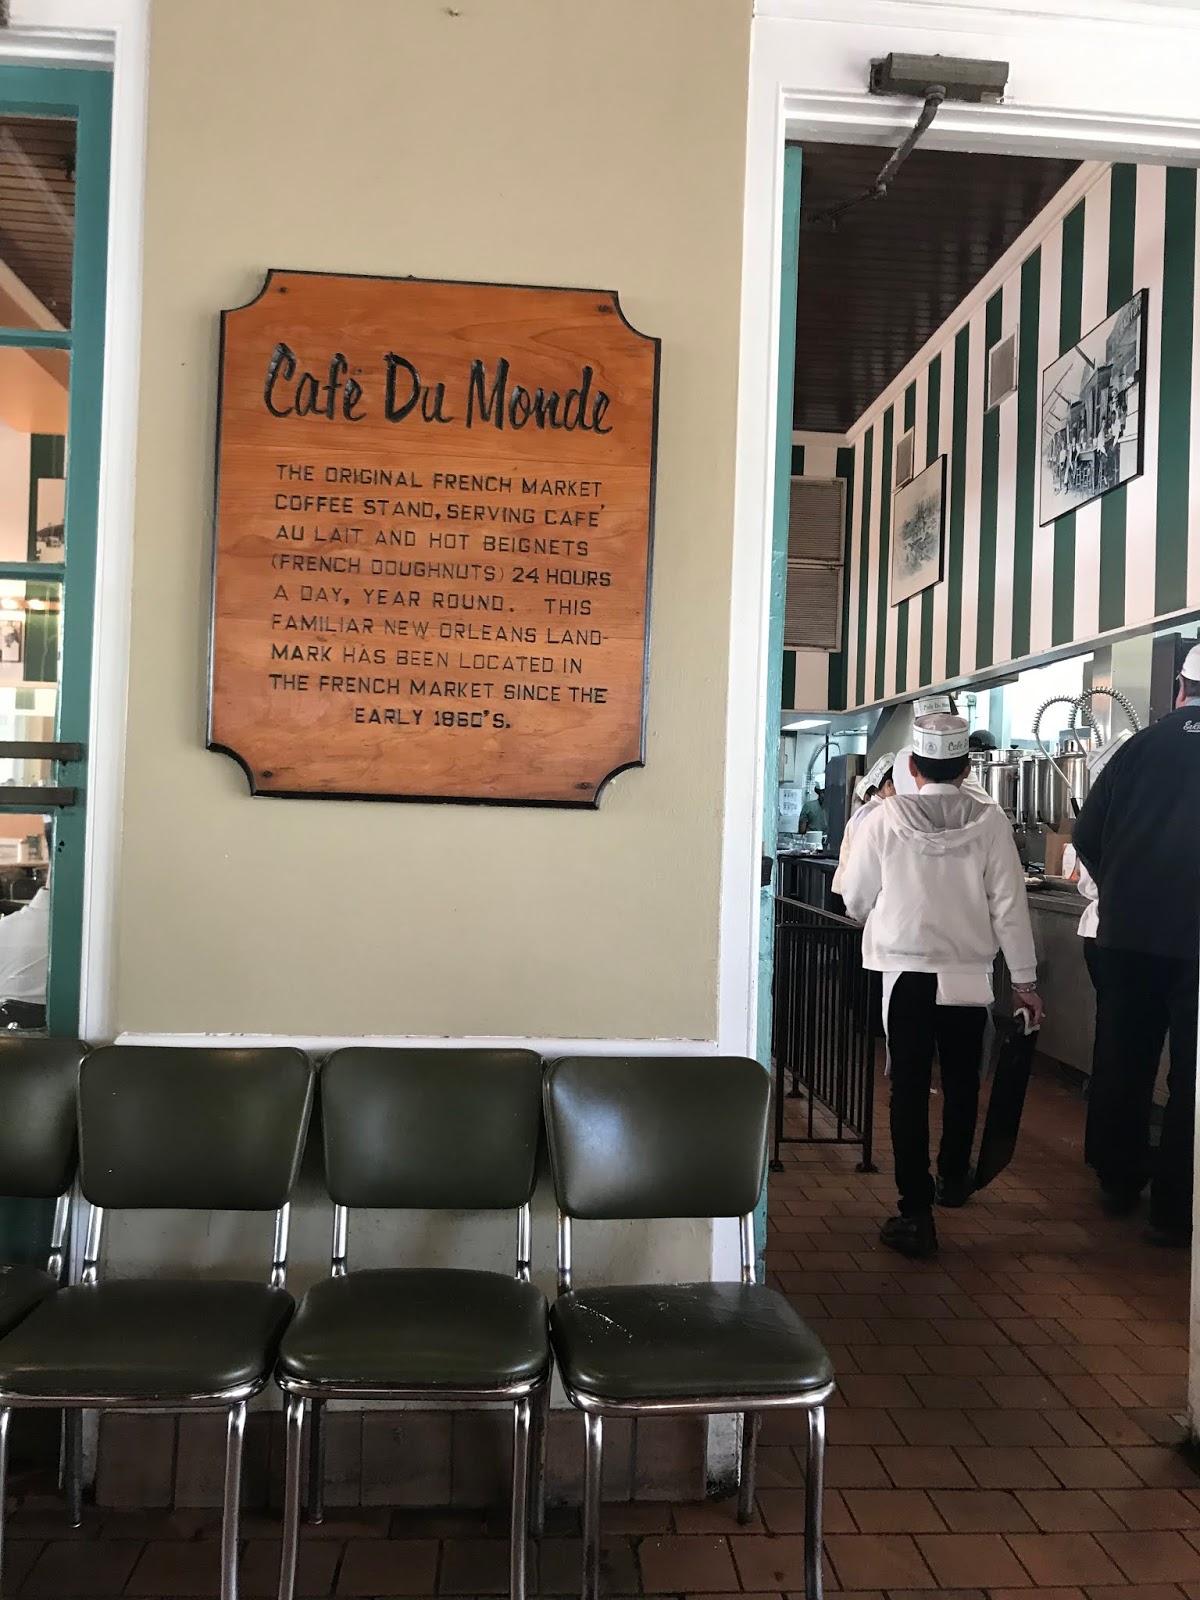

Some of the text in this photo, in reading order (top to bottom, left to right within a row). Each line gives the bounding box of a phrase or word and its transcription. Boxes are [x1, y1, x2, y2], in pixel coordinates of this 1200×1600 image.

[383, 351, 454, 424] Du
[465, 356, 613, 435] Monde
[276, 464, 602, 498] THE ORIGINAL FRENCH MARKET
[274, 493, 354, 514] COFFEE
[363, 499, 442, 521] STAND,
[447, 503, 536, 524] SERVING
[276, 524, 589, 557] AU LAIT AND HOT BEIGNETS
[271, 553, 612, 587] (FRENCH DOUGHNUTS) 24 HOURS
[273, 584, 592, 616] A DAY, YEAR ROUND. THIS
[271, 613, 609, 646] FAMILIAR NEW ORLEANS LAND-
[271, 643, 582, 674] MARK HAS BEEN LOCATED IN
[268, 673, 609, 704] THE FRENCH MARKET SINCE THE
[354, 707, 424, 726] EARLY
